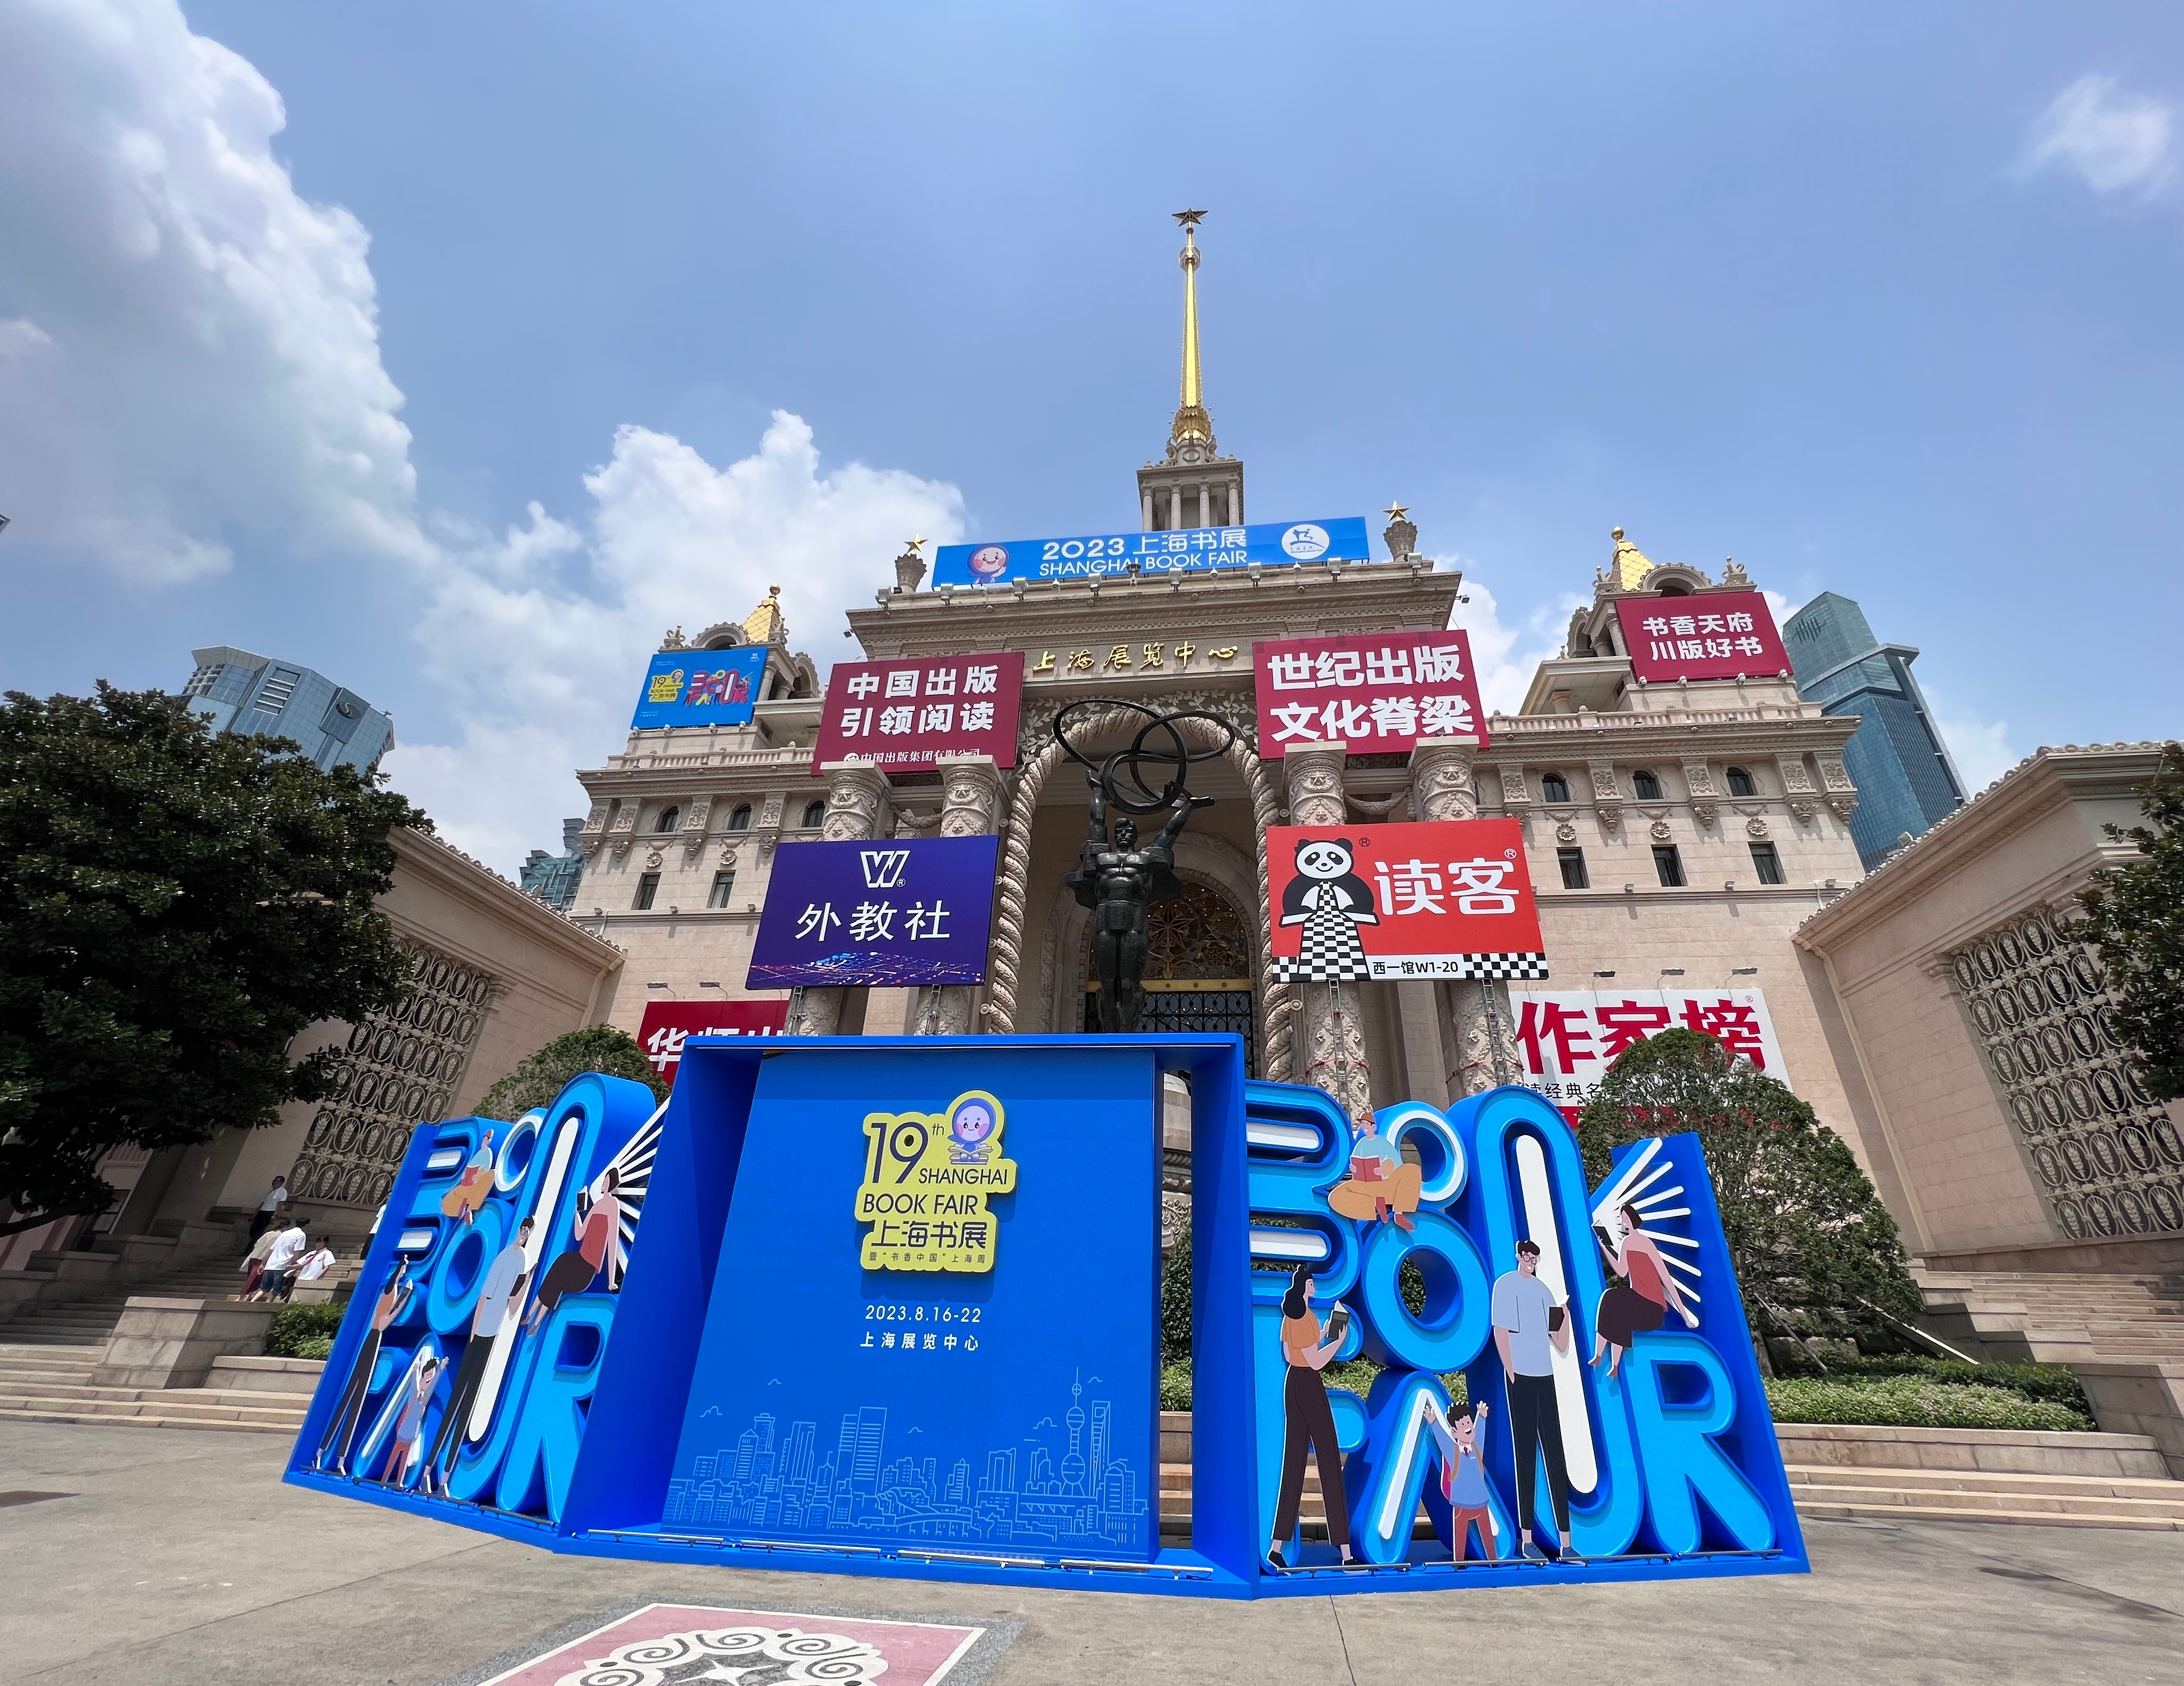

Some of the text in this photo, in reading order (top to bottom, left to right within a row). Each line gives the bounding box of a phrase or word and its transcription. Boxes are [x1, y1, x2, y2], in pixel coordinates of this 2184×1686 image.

[1042, 529, 1247, 560] 2023 上海书展
[1039, 550, 1247, 576] SHANGHAI BOOK FAIR
[1642, 612, 1754, 637] 书香天府
[1032, 640, 1238, 673] 上海展览中心
[1650, 636, 1764, 661] 川版好书
[847, 665, 999, 700] 中国出版
[1267, 644, 1465, 691] 世纪出版
[841, 701, 995, 737] 引领阅读
[1270, 695, 1475, 742] 文化脊梁
[1373, 857, 1520, 916] 读客
[795, 900, 951, 941] 外教社
[1373, 961, 1459, 975] 西一馆W1-20
[1516, 999, 1766, 1074] 作家榜
[919, 1168, 1008, 1185] SHANGHAI
[863, 1193, 978, 1215] BOOK FAIR
[871, 1220, 988, 1249] 上海书展
[865, 1304, 981, 1323] 2023.8.16-22
[860, 1331, 979, 1352] 上海展览中心
